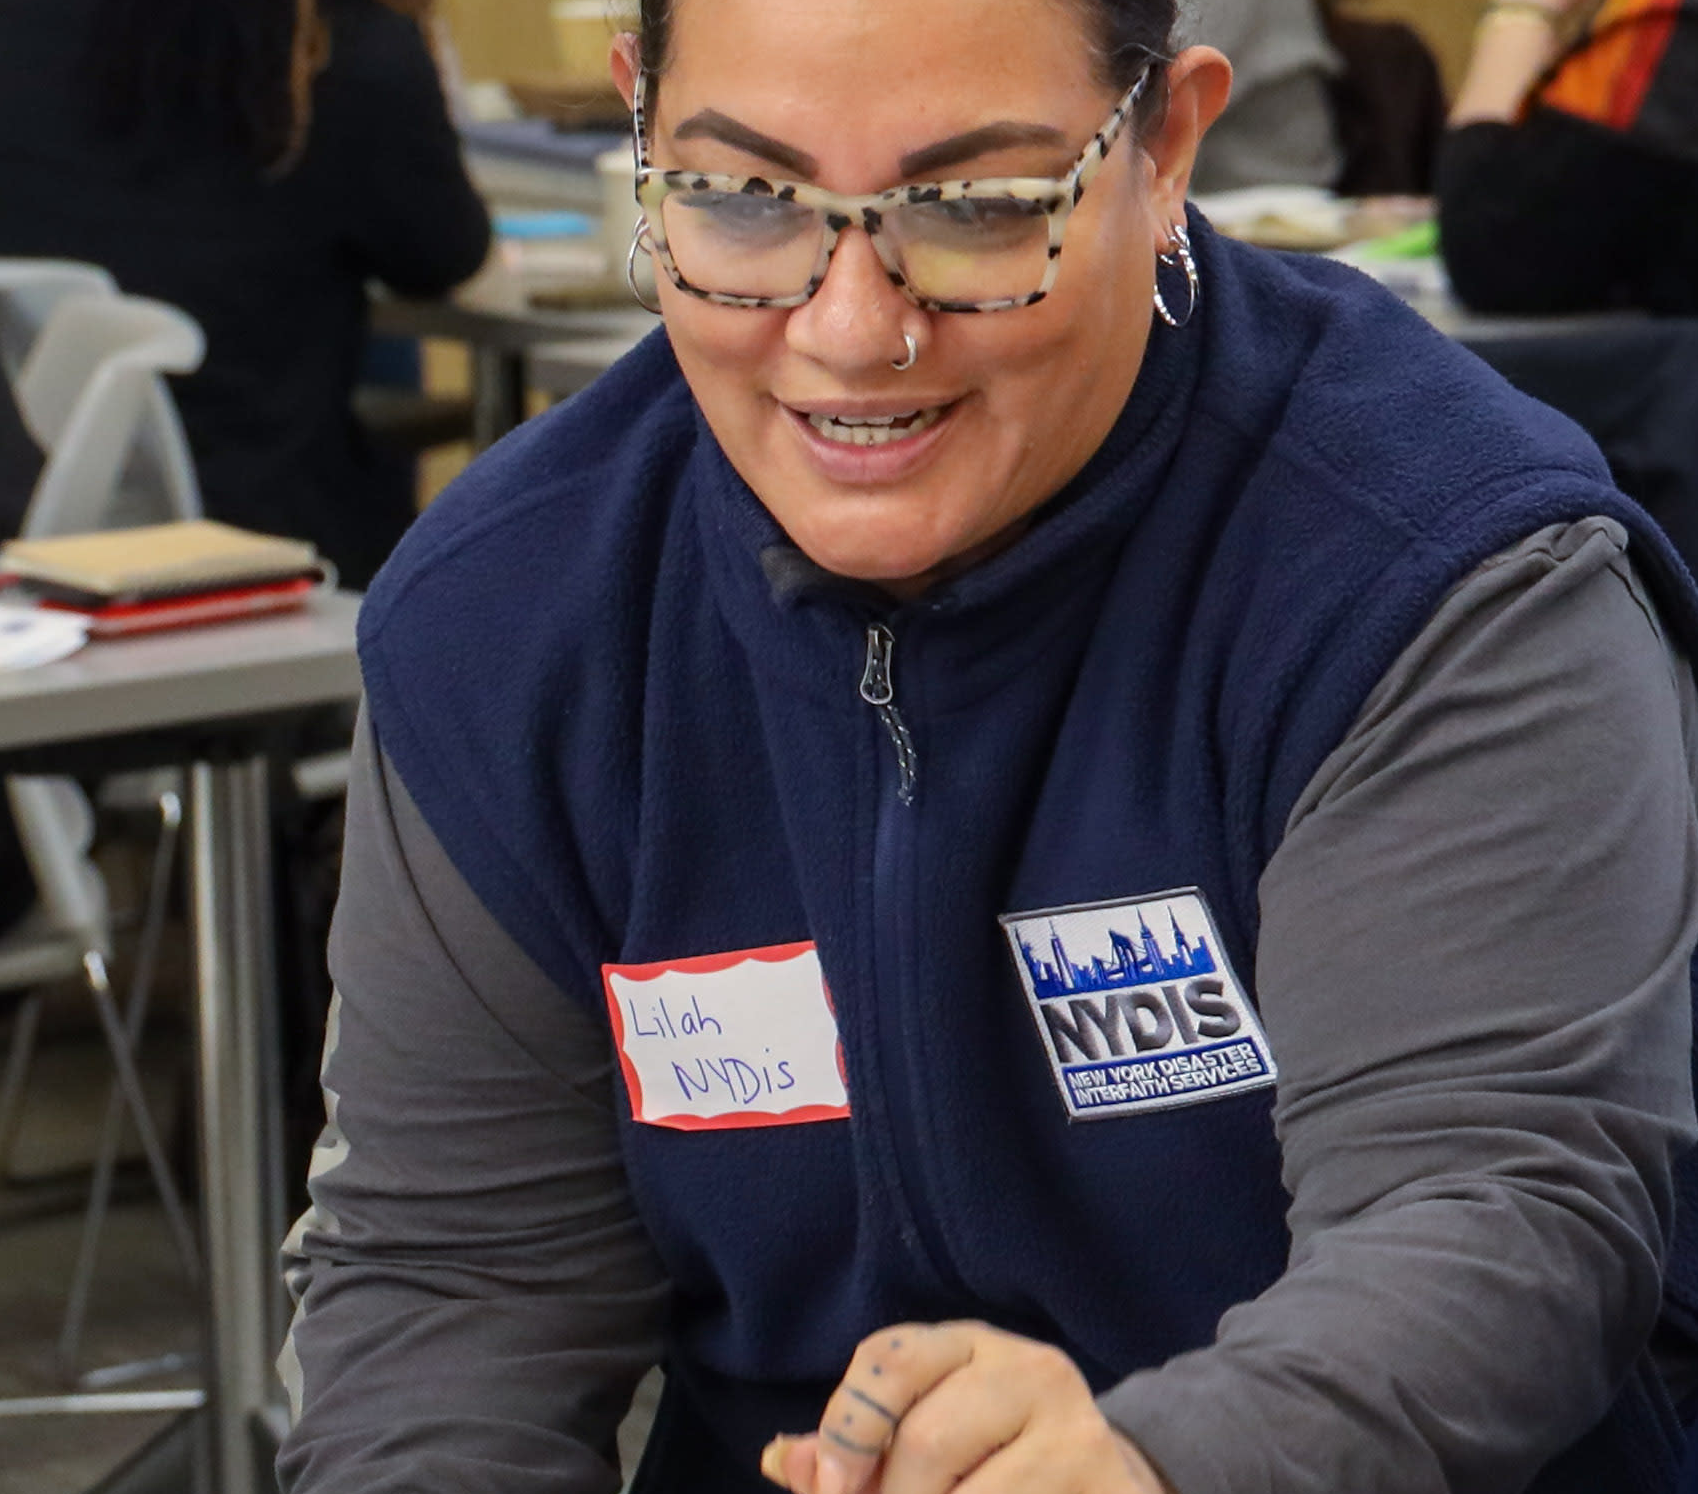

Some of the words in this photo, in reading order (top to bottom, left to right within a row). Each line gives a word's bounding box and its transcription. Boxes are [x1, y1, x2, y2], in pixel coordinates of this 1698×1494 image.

[628, 996, 723, 1040] Lilah
[1039, 979, 1242, 1063] NYDIS
[1068, 1069, 1106, 1089] NEW
[1108, 1061, 1160, 1084] YORK
[1162, 1043, 1258, 1077] DISASTER
[1074, 1076, 1169, 1107] INTERFAITH
[1169, 1059, 1263, 1091] SERVICES
